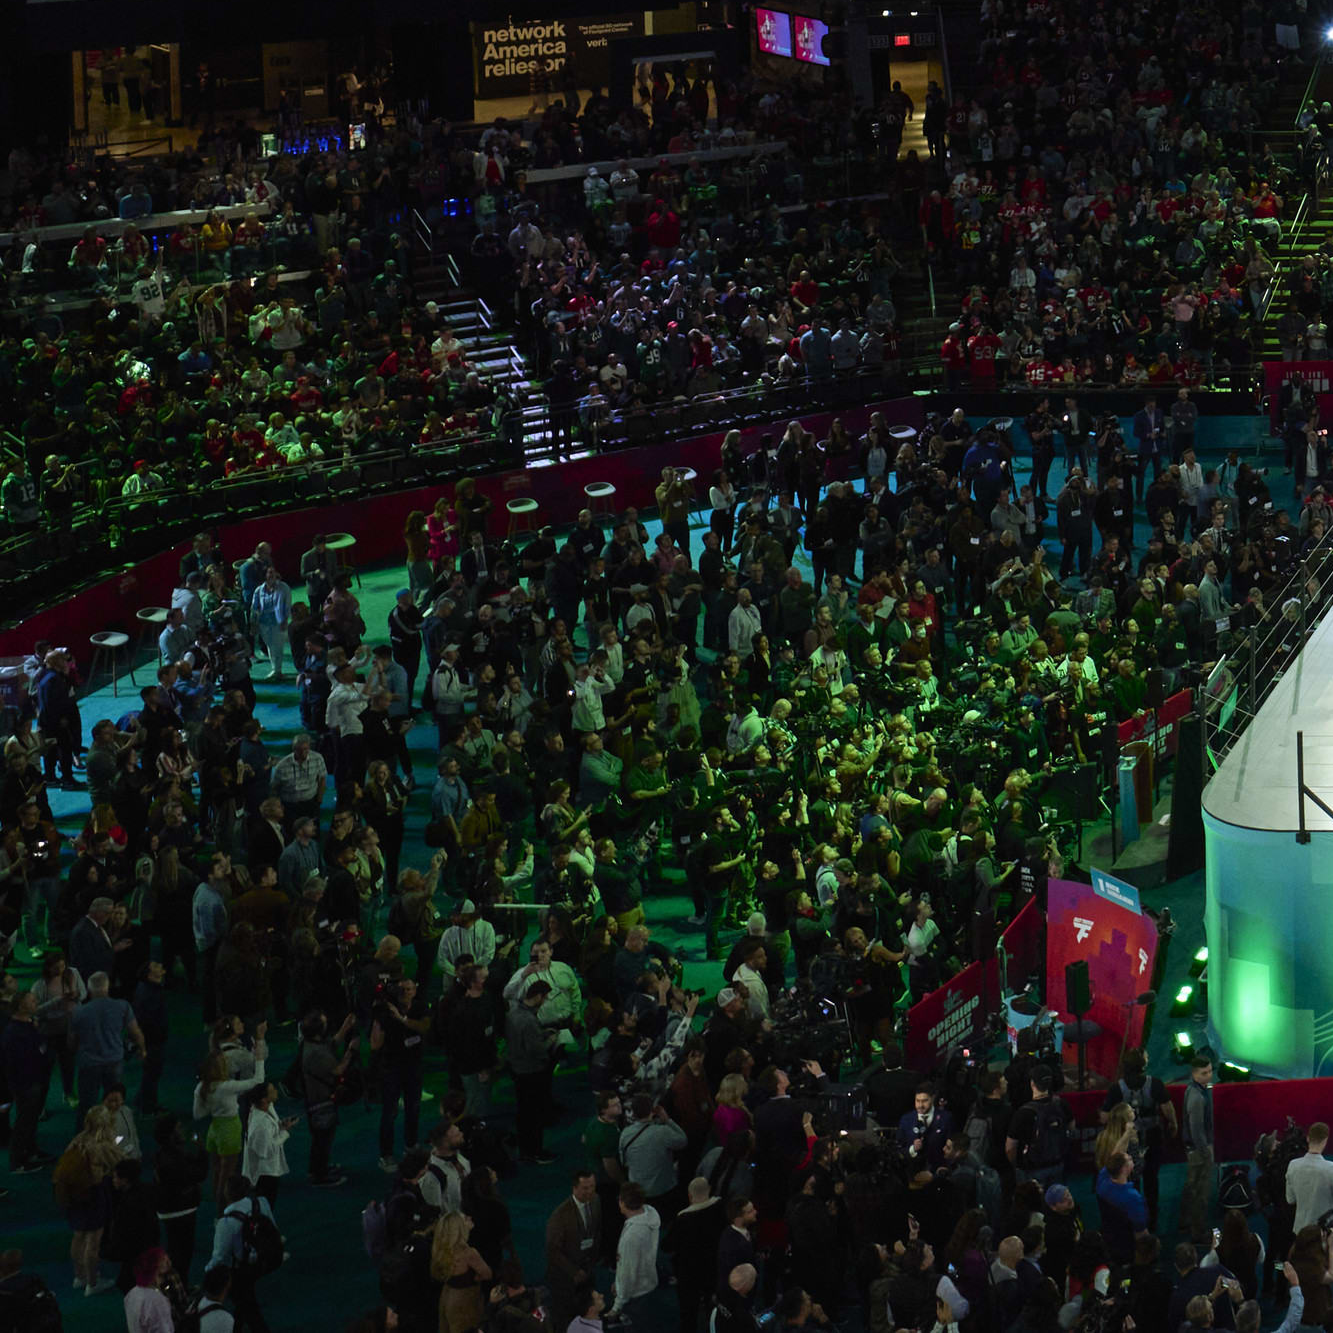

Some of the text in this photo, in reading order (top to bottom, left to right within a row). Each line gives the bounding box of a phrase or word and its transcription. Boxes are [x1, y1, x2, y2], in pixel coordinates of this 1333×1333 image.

[484, 20, 566, 43] network
[483, 39, 567, 60] America
[484, 58, 537, 77] relies
[141, 285, 159, 301] 92
[20, 483, 35, 502] 12
[927, 994, 980, 1042] OPENING
[936, 1012, 972, 1048] NIGHT
